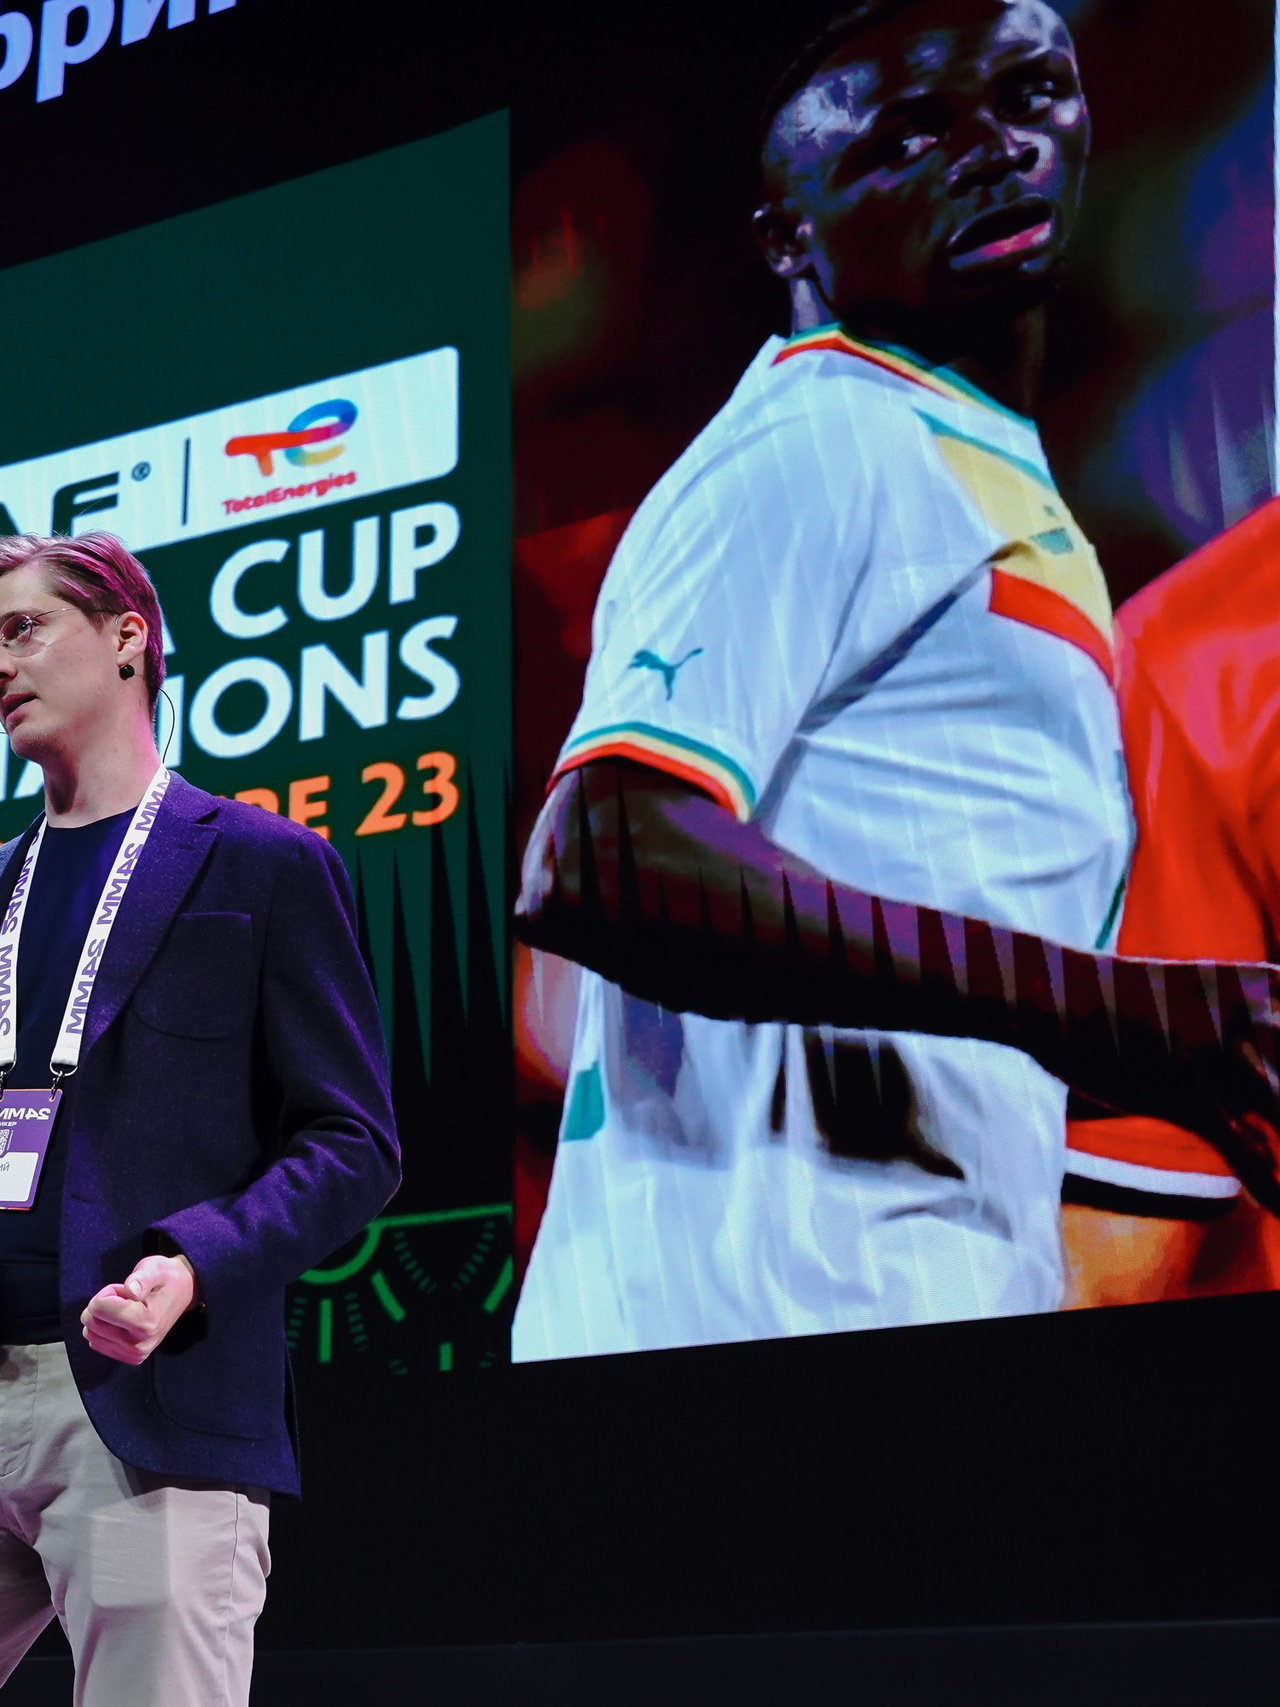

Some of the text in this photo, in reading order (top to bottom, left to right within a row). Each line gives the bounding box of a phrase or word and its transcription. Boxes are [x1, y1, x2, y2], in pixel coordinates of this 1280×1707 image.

[222, 471, 357, 516] TotalEnergies
[210, 502, 462, 639] CUP
[354, 750, 460, 837] 23
